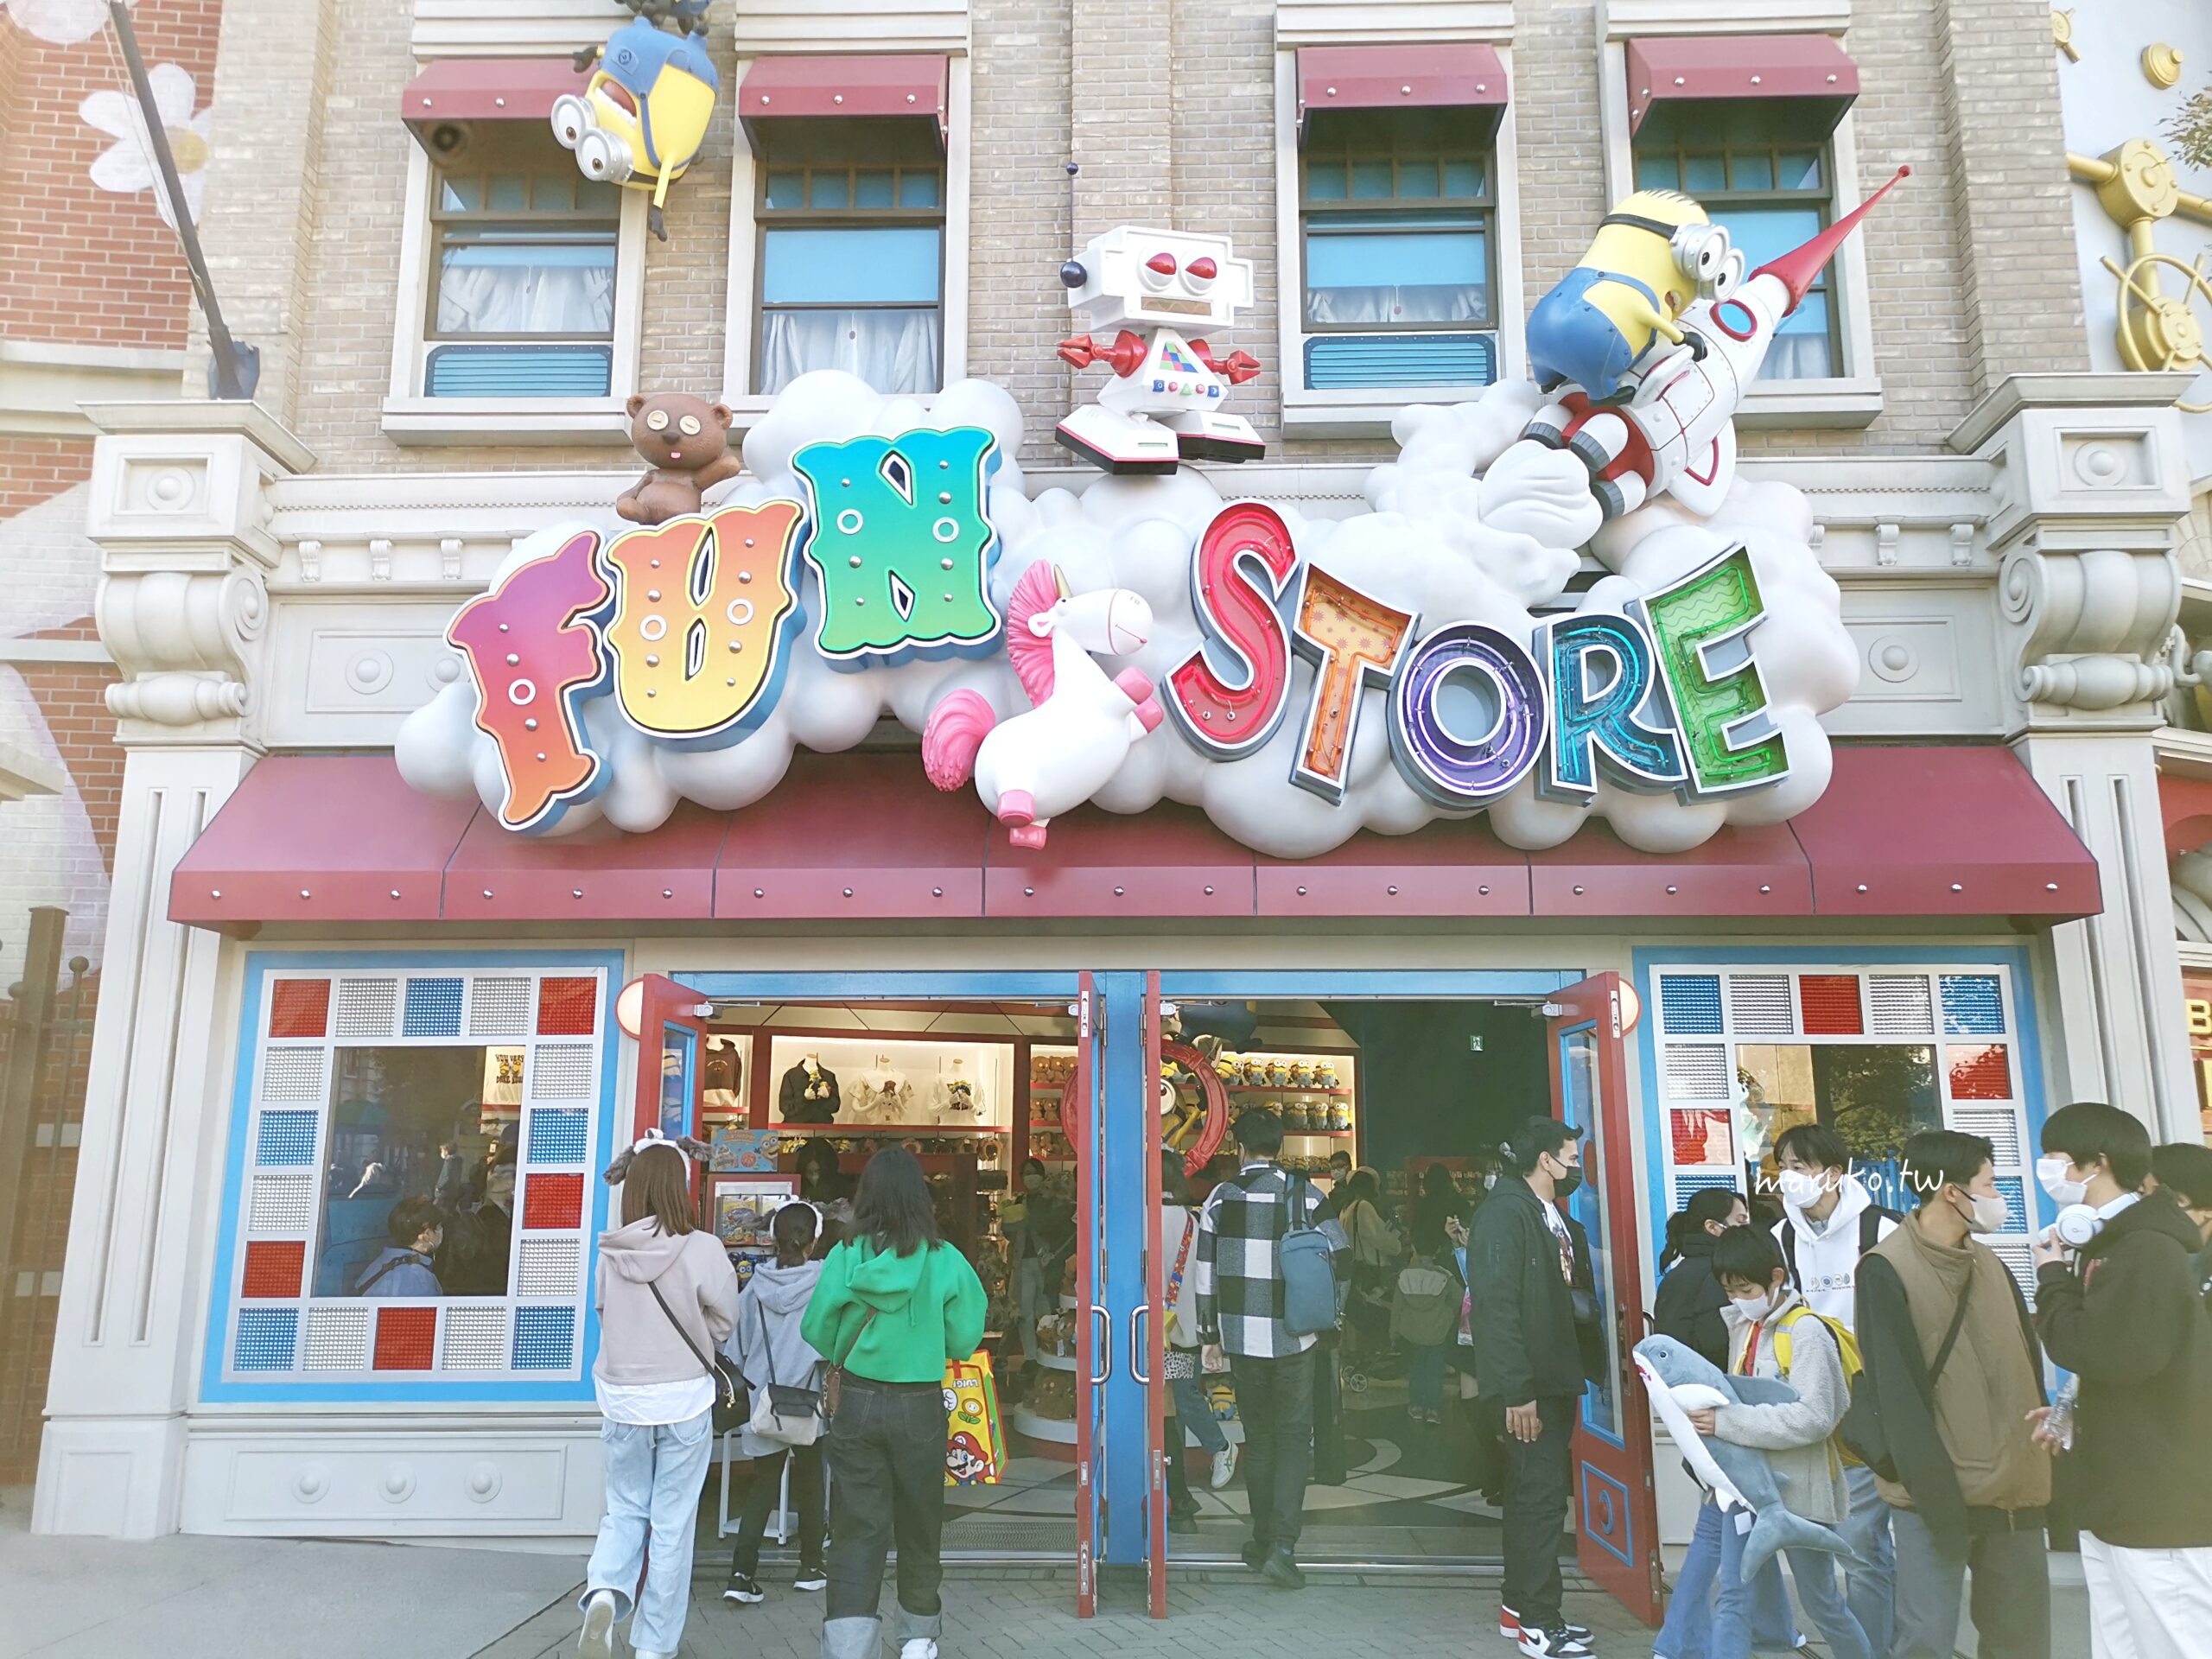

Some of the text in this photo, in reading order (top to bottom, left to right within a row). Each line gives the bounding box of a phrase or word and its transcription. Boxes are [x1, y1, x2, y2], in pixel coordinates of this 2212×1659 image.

[444, 424, 1001, 834] FUN
[1161, 499, 1791, 806] STORE
[953, 1379, 979, 1389] LUIGI
